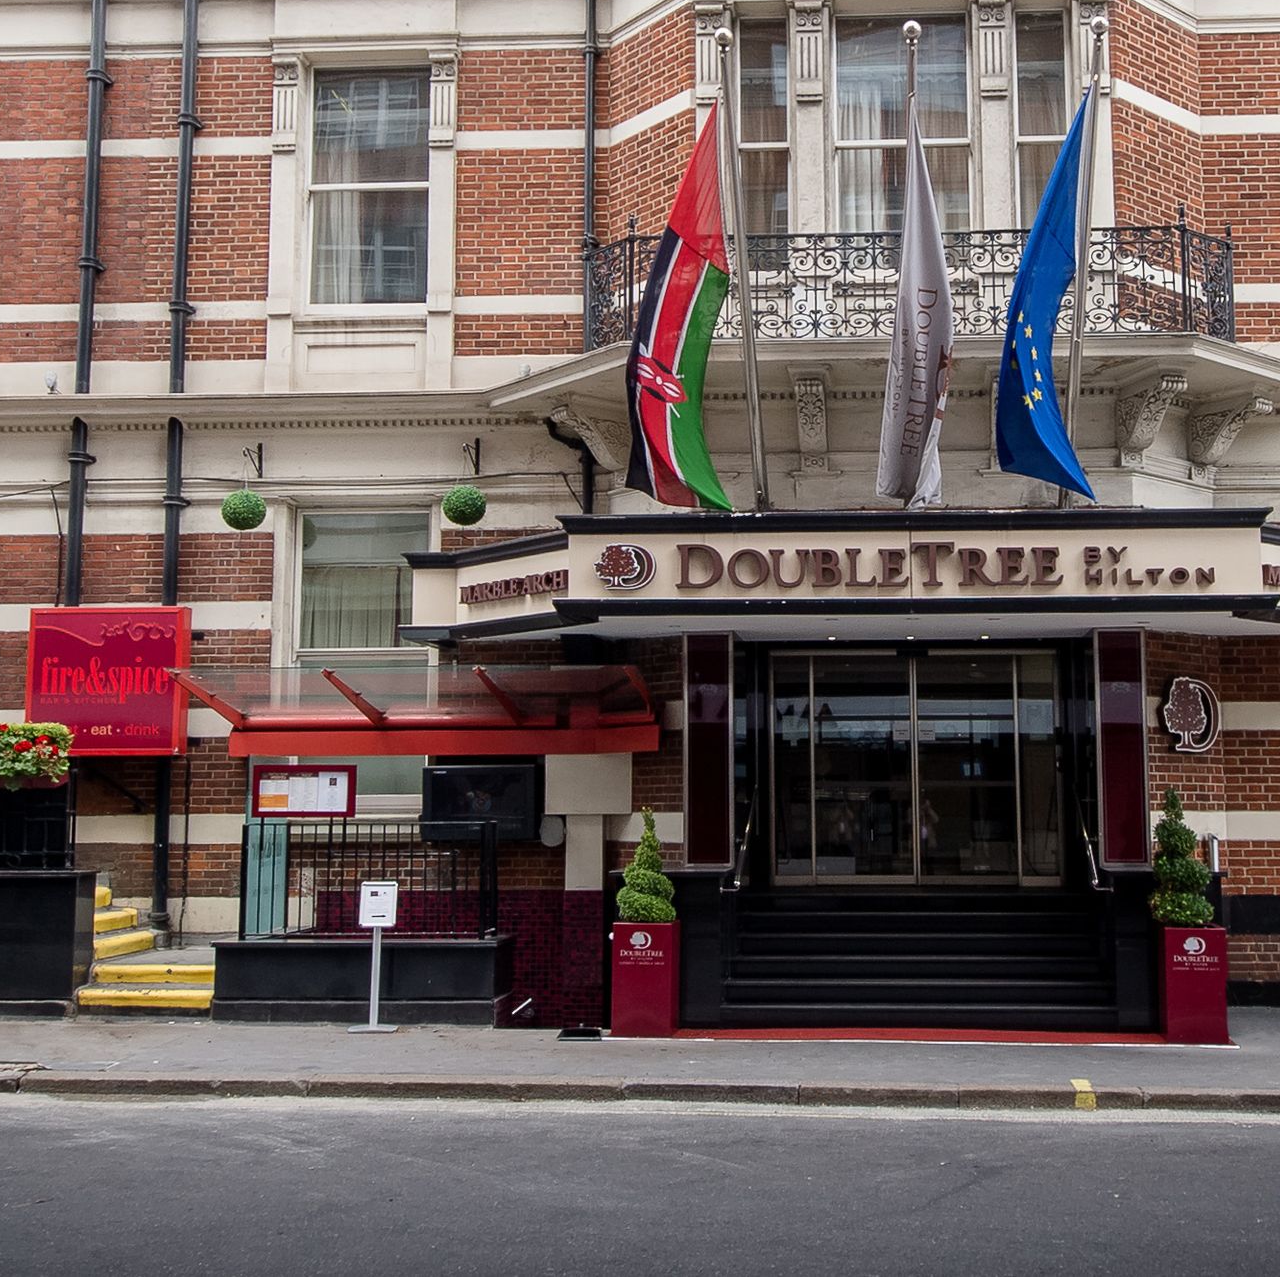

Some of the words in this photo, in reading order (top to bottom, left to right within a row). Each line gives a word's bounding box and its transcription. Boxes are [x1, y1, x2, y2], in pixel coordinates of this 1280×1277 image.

[900, 288, 938, 458] DOUBLETREE
[675, 541, 1064, 589] DOUBLETREE
[1083, 546, 1128, 564] BY
[459, 578, 522, 605] MARBLE
[521, 569, 569, 596] ARCH
[1084, 567, 1216, 586] HILTON
[40, 656, 169, 704] fire&spice
[90, 724, 113, 736] eat
[124, 723, 160, 736] drink
